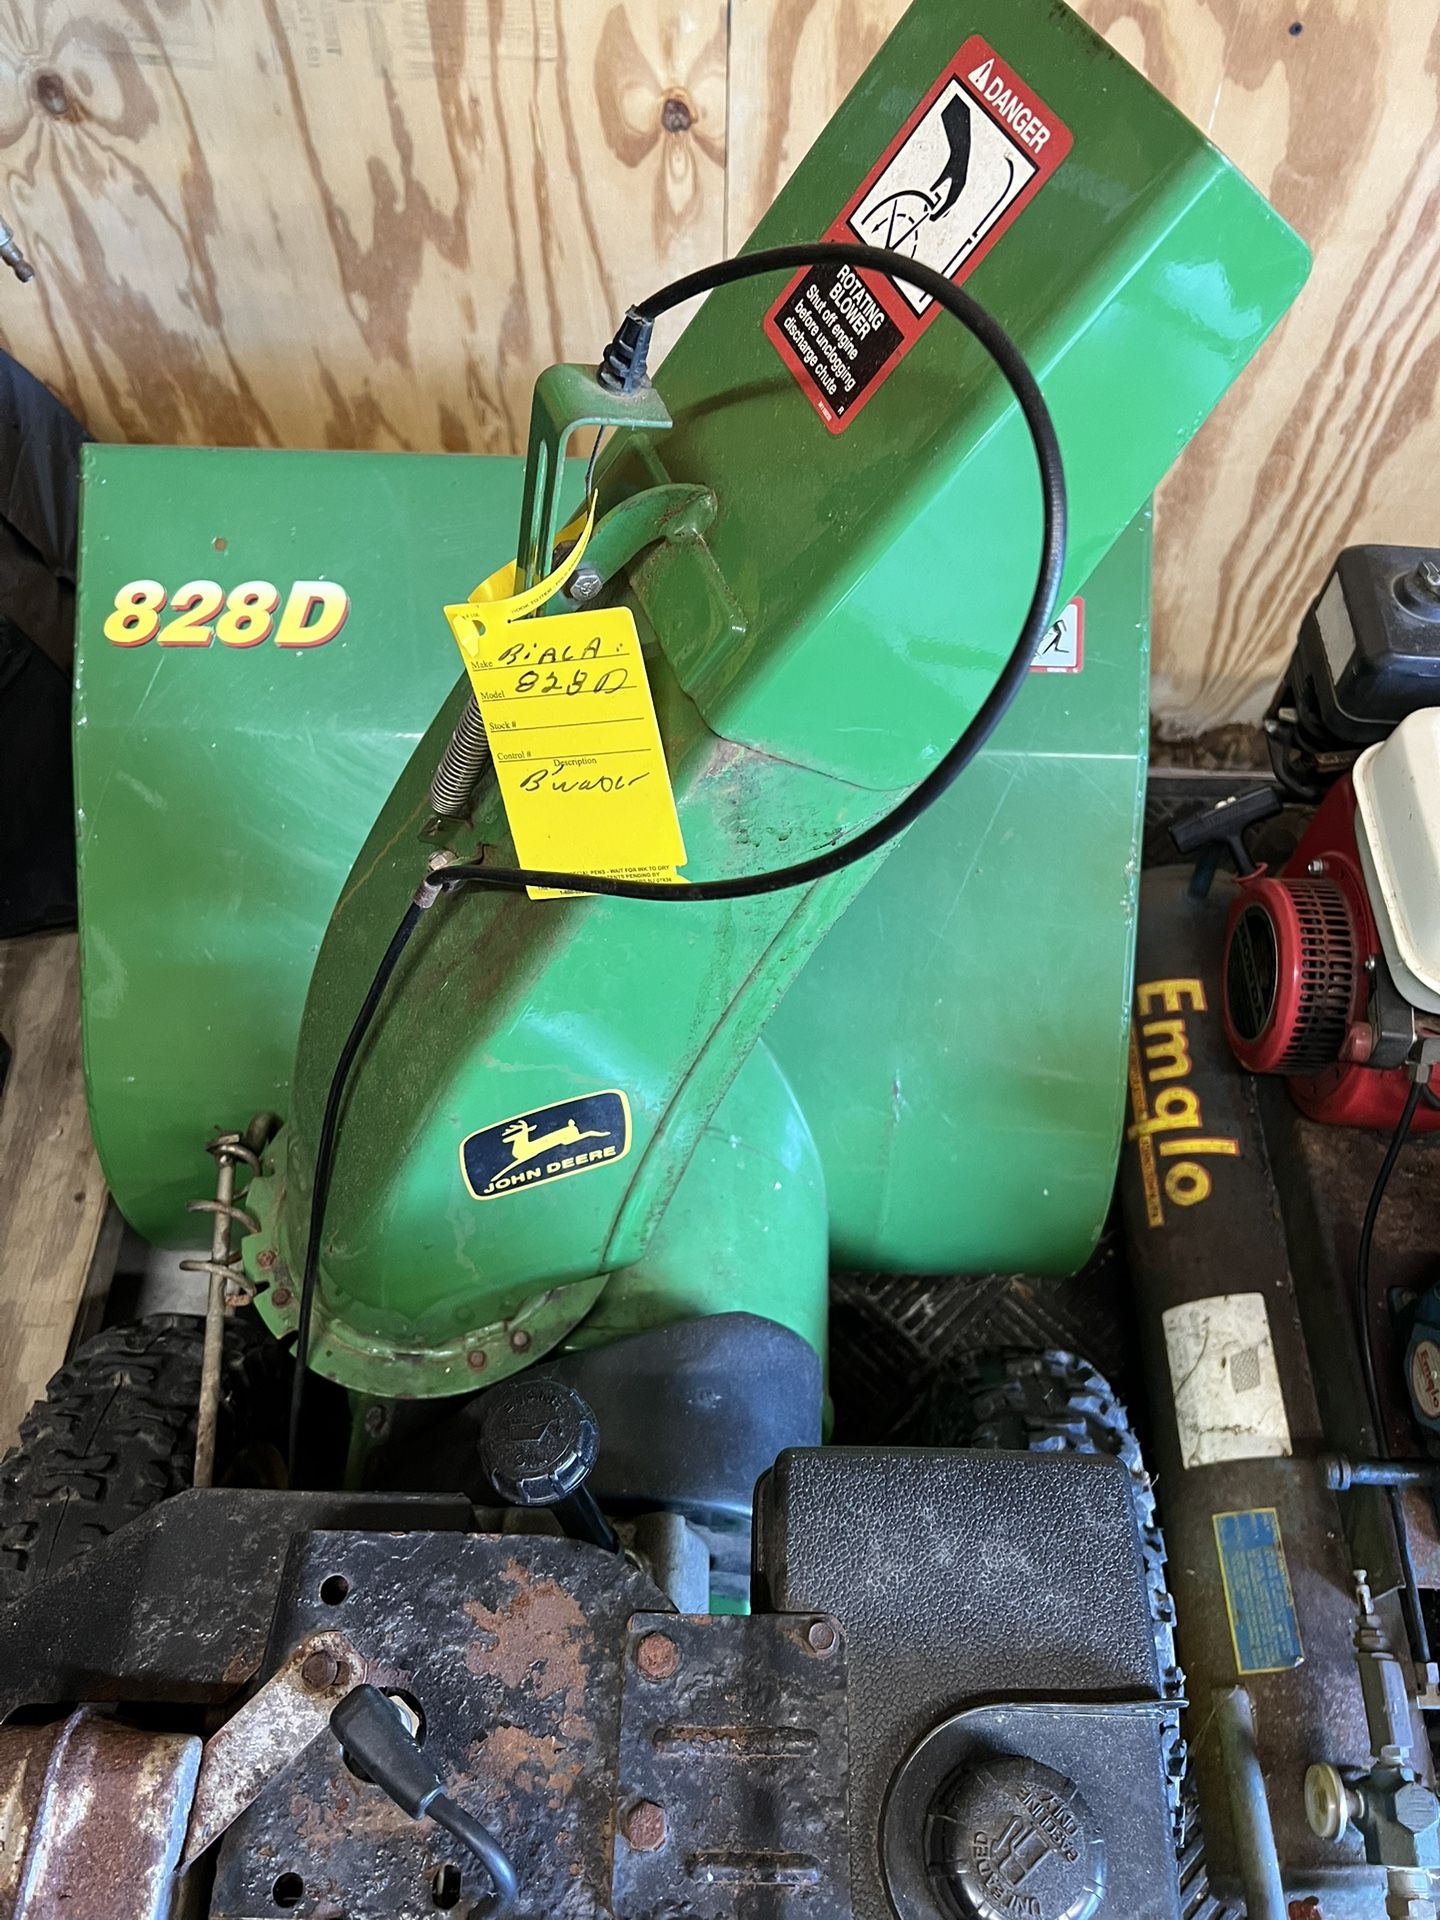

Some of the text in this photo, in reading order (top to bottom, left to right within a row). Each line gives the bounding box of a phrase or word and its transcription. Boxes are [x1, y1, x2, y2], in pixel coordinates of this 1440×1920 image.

[983, 76, 1051, 154] DANGER
[806, 284, 859, 360] Shut off engine
[829, 282, 871, 341] BLOWER
[836, 264, 885, 331] ROTATING
[783, 316, 818, 367] discharge
[815, 362, 837, 395] chute
[794, 299, 818, 336] before
[816, 330, 857, 393] unclogging
[103, 579, 350, 649] 828D
[471, 660, 493, 669] Make
[480, 691, 505, 700] Model
[489, 721, 512, 731] Stock
[497, 752, 525, 761] Control
[553, 756, 597, 768] Description
[483, 1145, 616, 1194] JOHN DEERE
